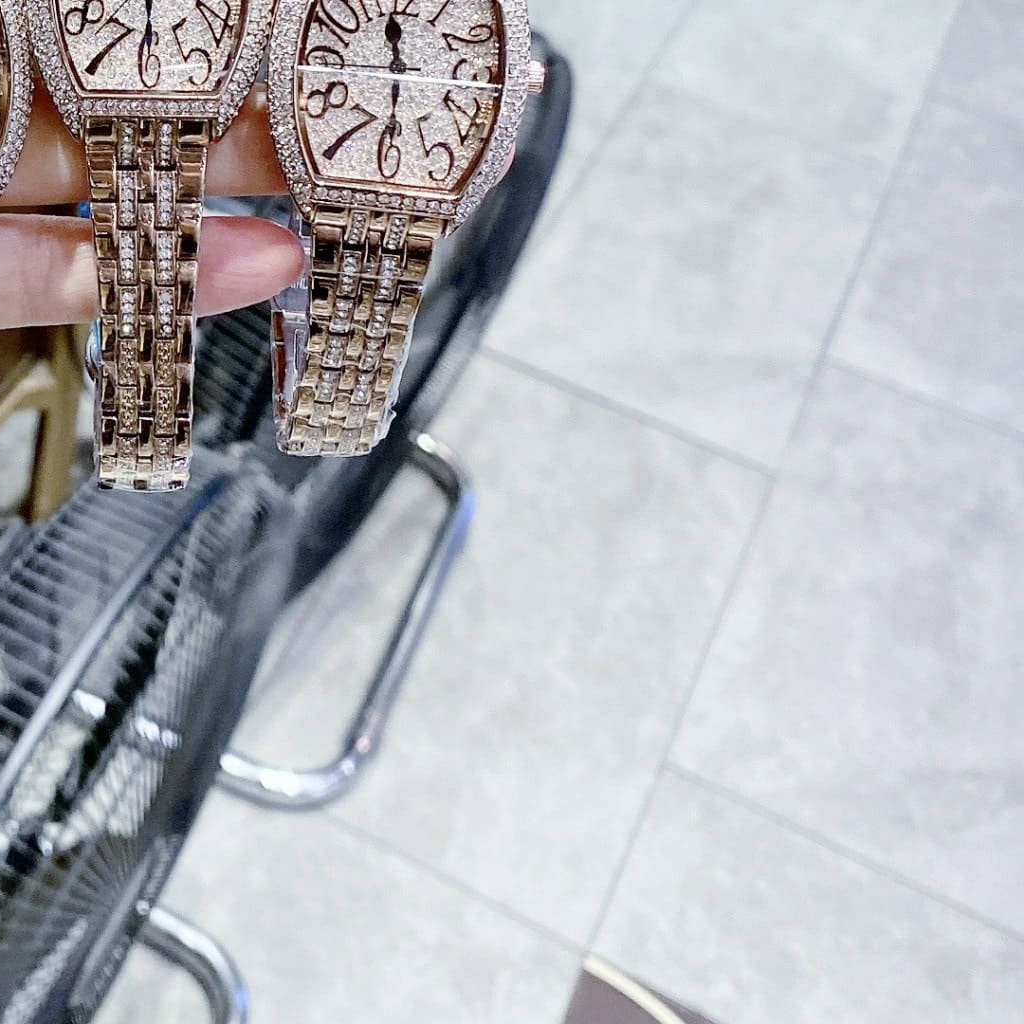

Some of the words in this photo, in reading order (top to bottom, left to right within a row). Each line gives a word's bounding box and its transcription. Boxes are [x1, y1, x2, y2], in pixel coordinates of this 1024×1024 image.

[85, 16, 135, 76] 7
[138, 31, 160, 89] 6
[173, 17, 212, 86] 5
[442, 24, 493, 51] 2
[306, 80, 348, 118] 8
[443, 90, 482, 146] 4
[322, 104, 378, 160] 7
[377, 118, 402, 179] 6
[416, 113, 454, 182] 5
